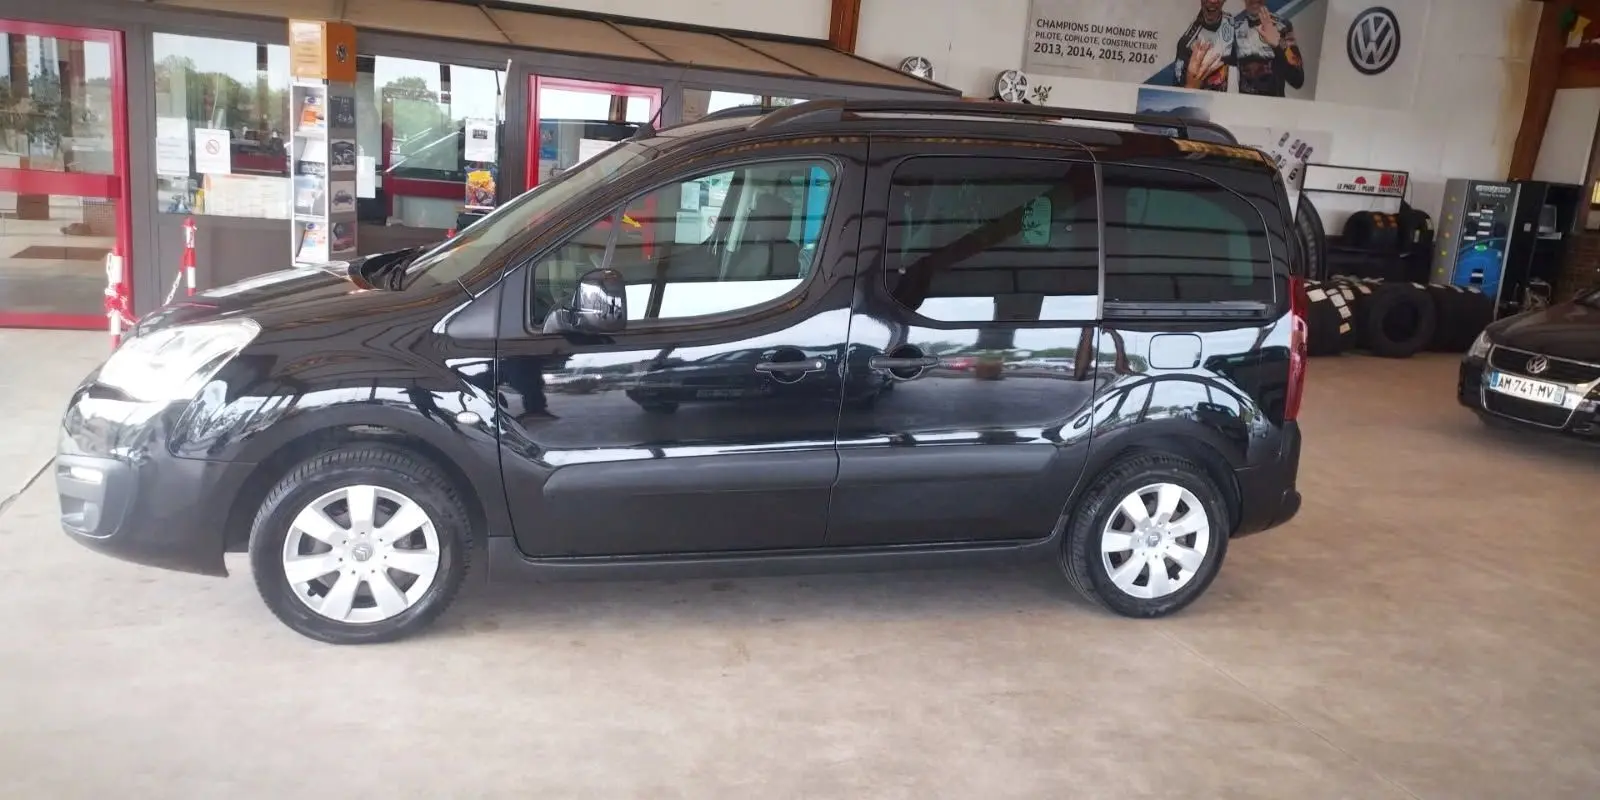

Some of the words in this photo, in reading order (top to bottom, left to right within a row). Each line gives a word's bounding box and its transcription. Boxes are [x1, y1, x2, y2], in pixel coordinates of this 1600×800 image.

[1036, 19, 1089, 33] CHAMPIONS
[1091, 24, 1104, 34] DU
[1105, 26, 1136, 38] MONDE
[1138, 30, 1159, 40] WRC
[1035, 31, 1062, 42] PILOTE,
[1101, 37, 1158, 50] CONSTRUCTEUR
[1033, 42, 1064, 57] 2013,
[1066, 45, 1095, 60] 2014,
[1098, 48, 1126, 63] 2015,
